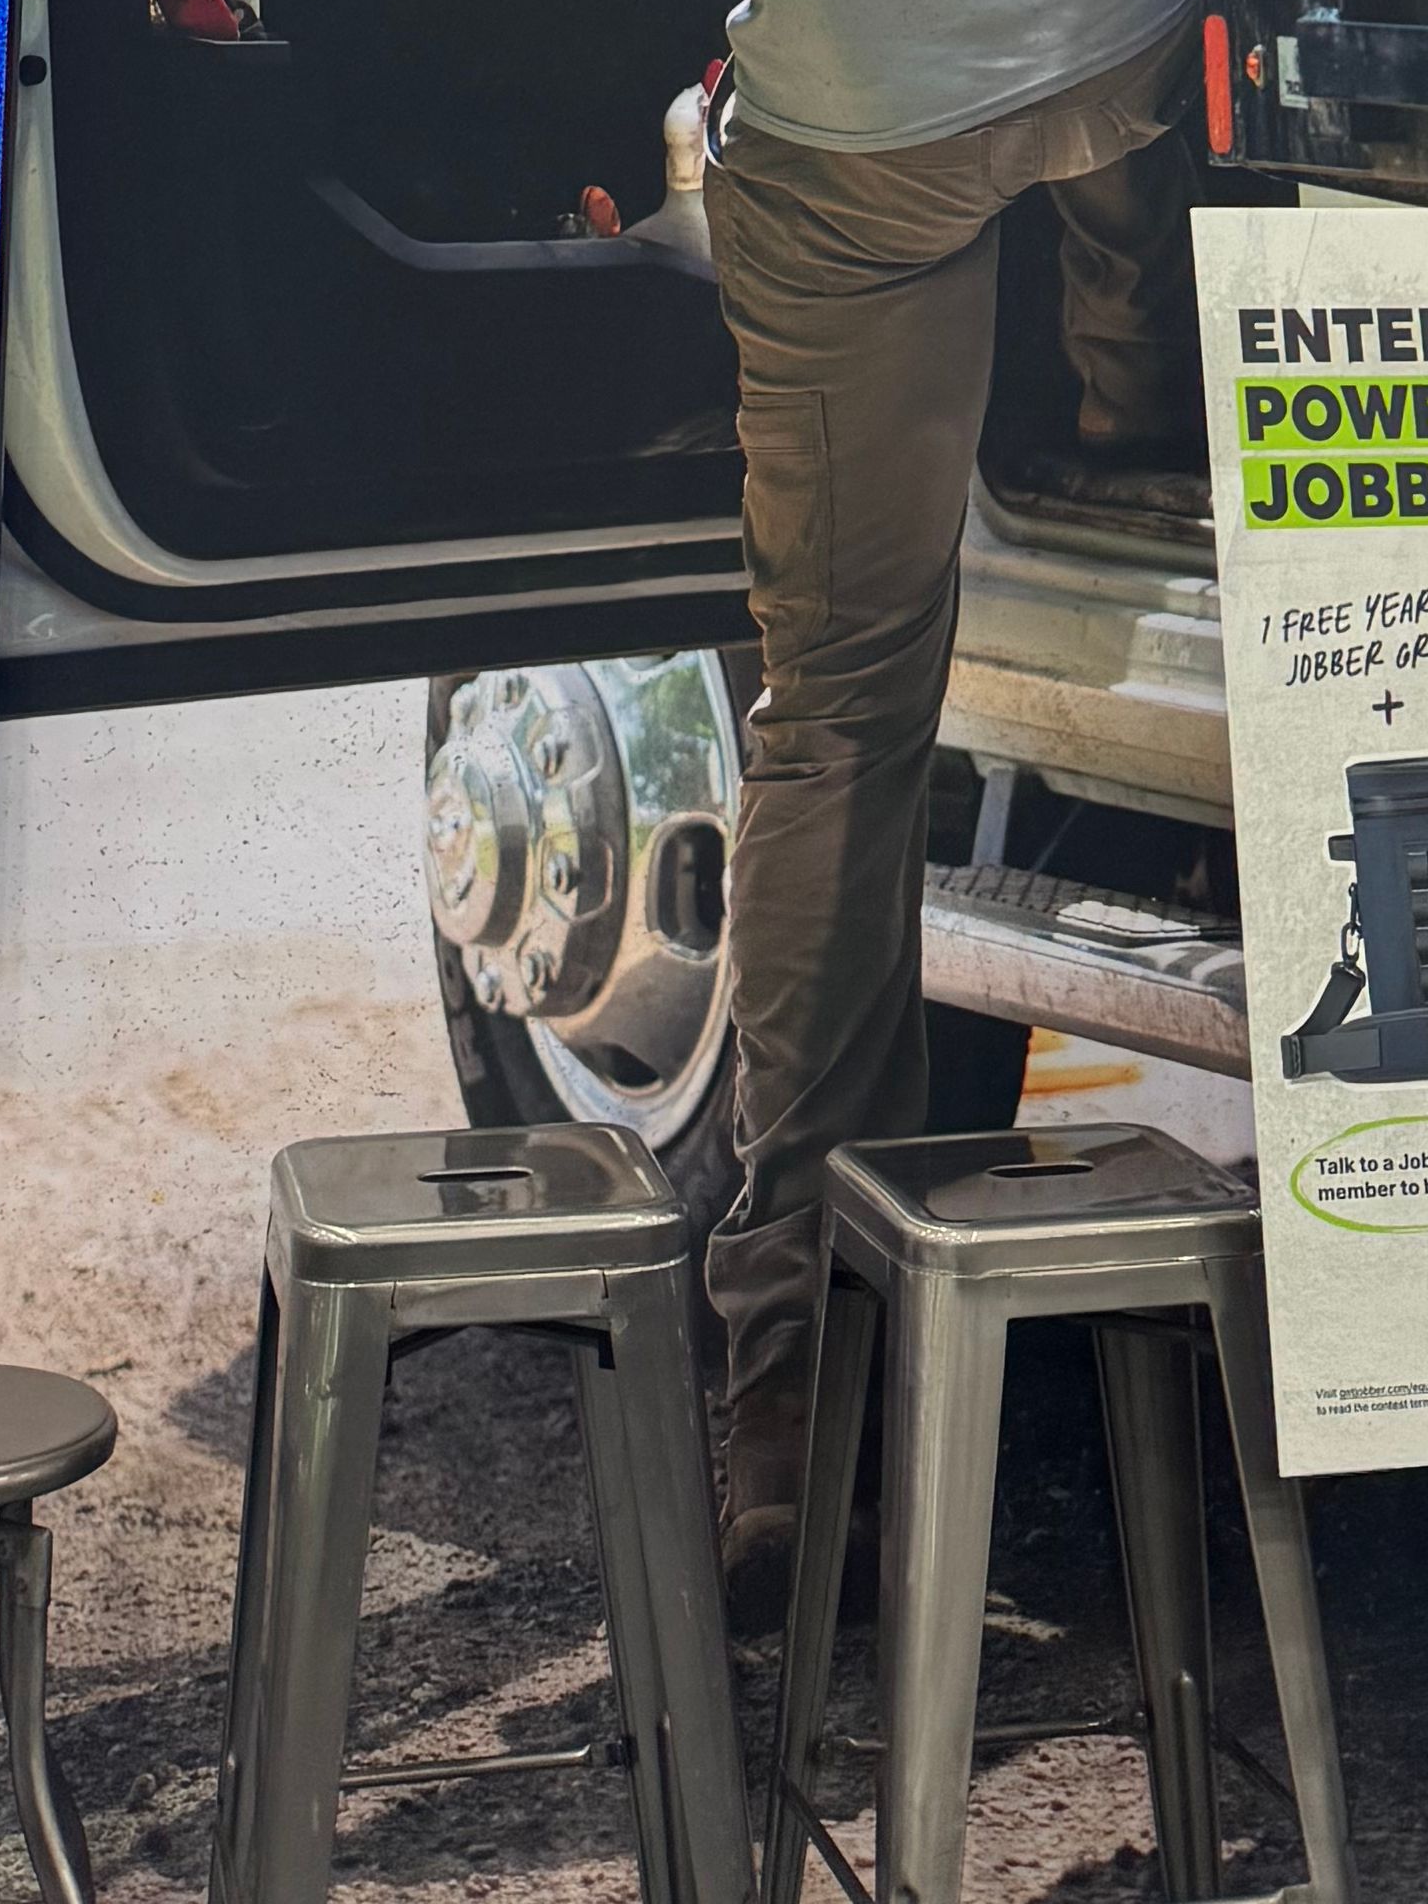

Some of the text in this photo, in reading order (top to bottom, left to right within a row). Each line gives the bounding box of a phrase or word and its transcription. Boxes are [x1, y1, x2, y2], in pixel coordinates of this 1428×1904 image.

[1261, 615, 1272, 645] 1
[1282, 601, 1355, 644] FREE
[1285, 639, 1385, 687] JOBBER
[1315, 1157, 1356, 1176] Talk
[1359, 1157, 1379, 1173] to
[1382, 1158, 1395, 1172] a
[1318, 1181, 1397, 1202] member
[1400, 1180, 1421, 1196] to
[1372, 1400, 1409, 1412] contest
